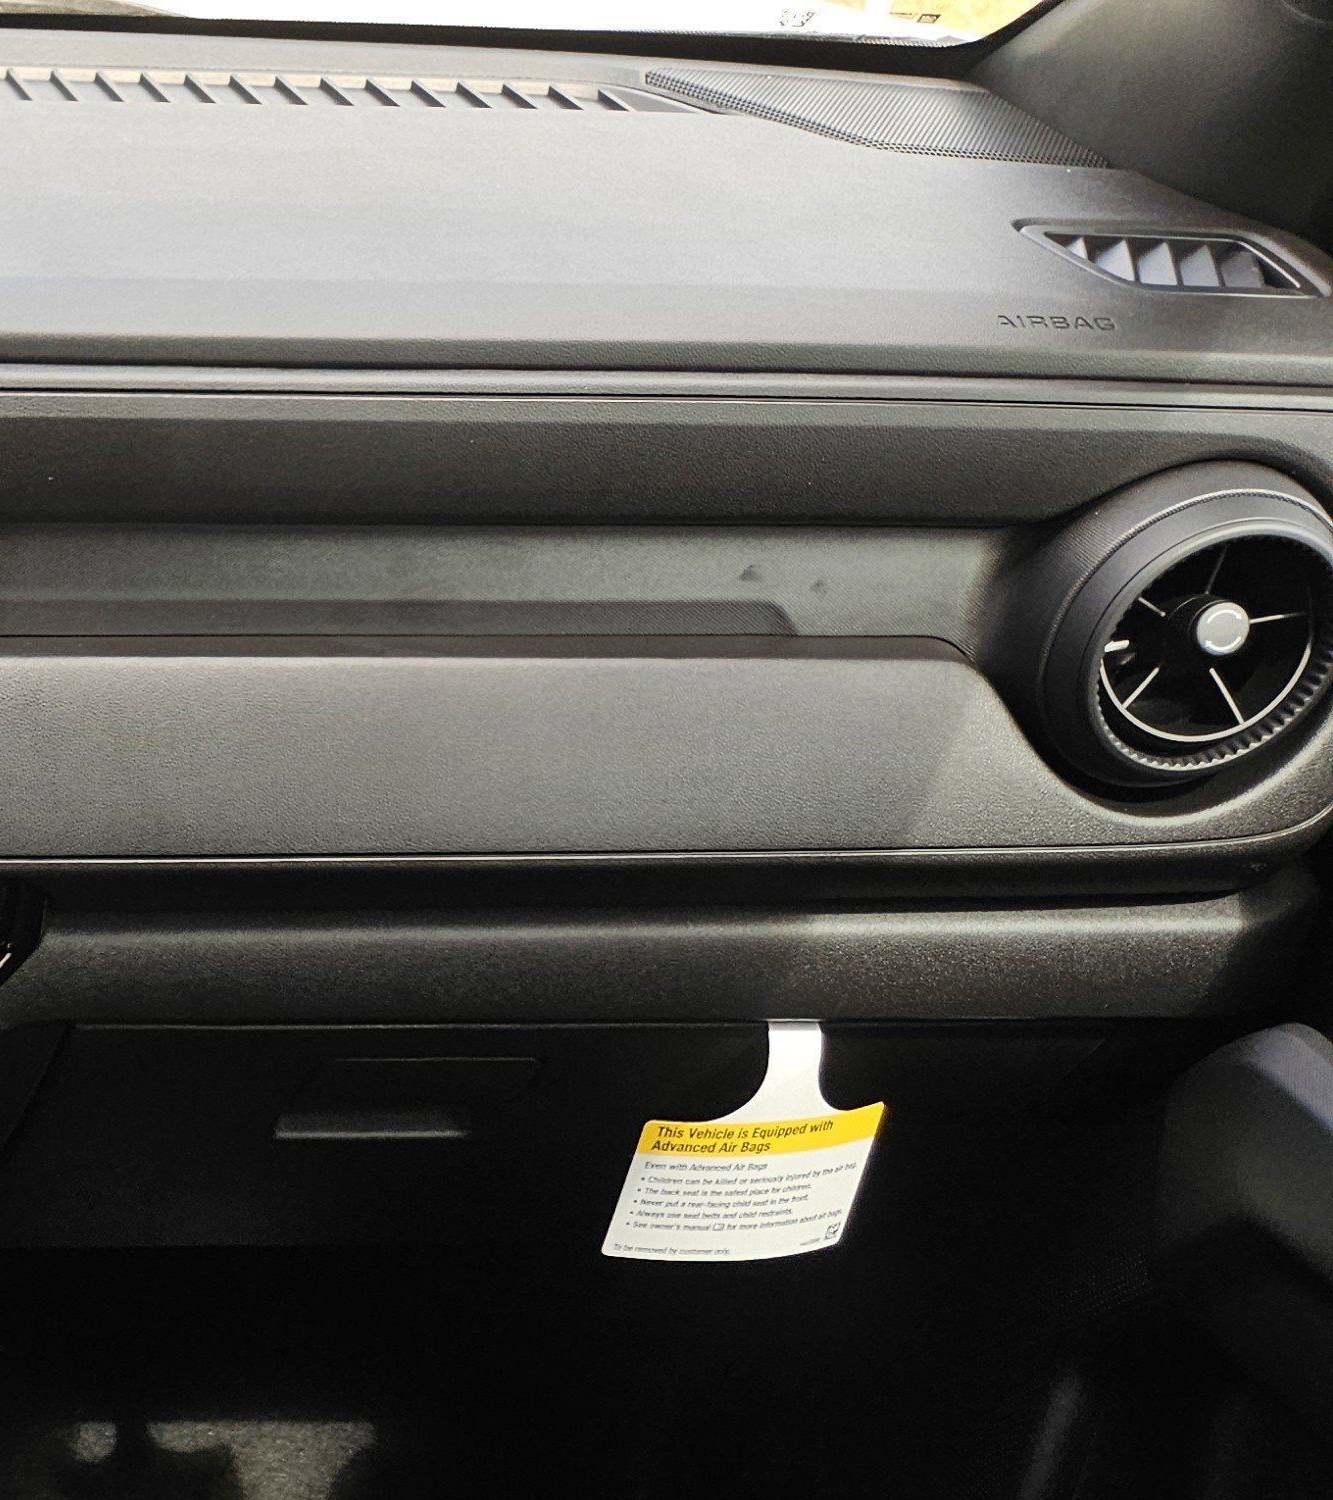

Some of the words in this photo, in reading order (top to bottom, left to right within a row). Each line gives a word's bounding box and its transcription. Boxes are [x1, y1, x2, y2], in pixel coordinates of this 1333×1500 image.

[997, 315, 1115, 331] AIRBAG
[657, 1126, 684, 1139] This
[689, 1128, 735, 1140] Vehicle
[737, 1127, 748, 1139] is
[752, 1123, 808, 1140] Equipped
[810, 1120, 834, 1133] with
[651, 1140, 716, 1153] Advanced
[719, 1142, 738, 1153] Air
[740, 1141, 771, 1154] Bags
[644, 1161, 667, 1169] Even
[689, 1163, 732, 1171] Advanced
[733, 1163, 746, 1171] Air
[747, 1163, 768, 1172] Bags
